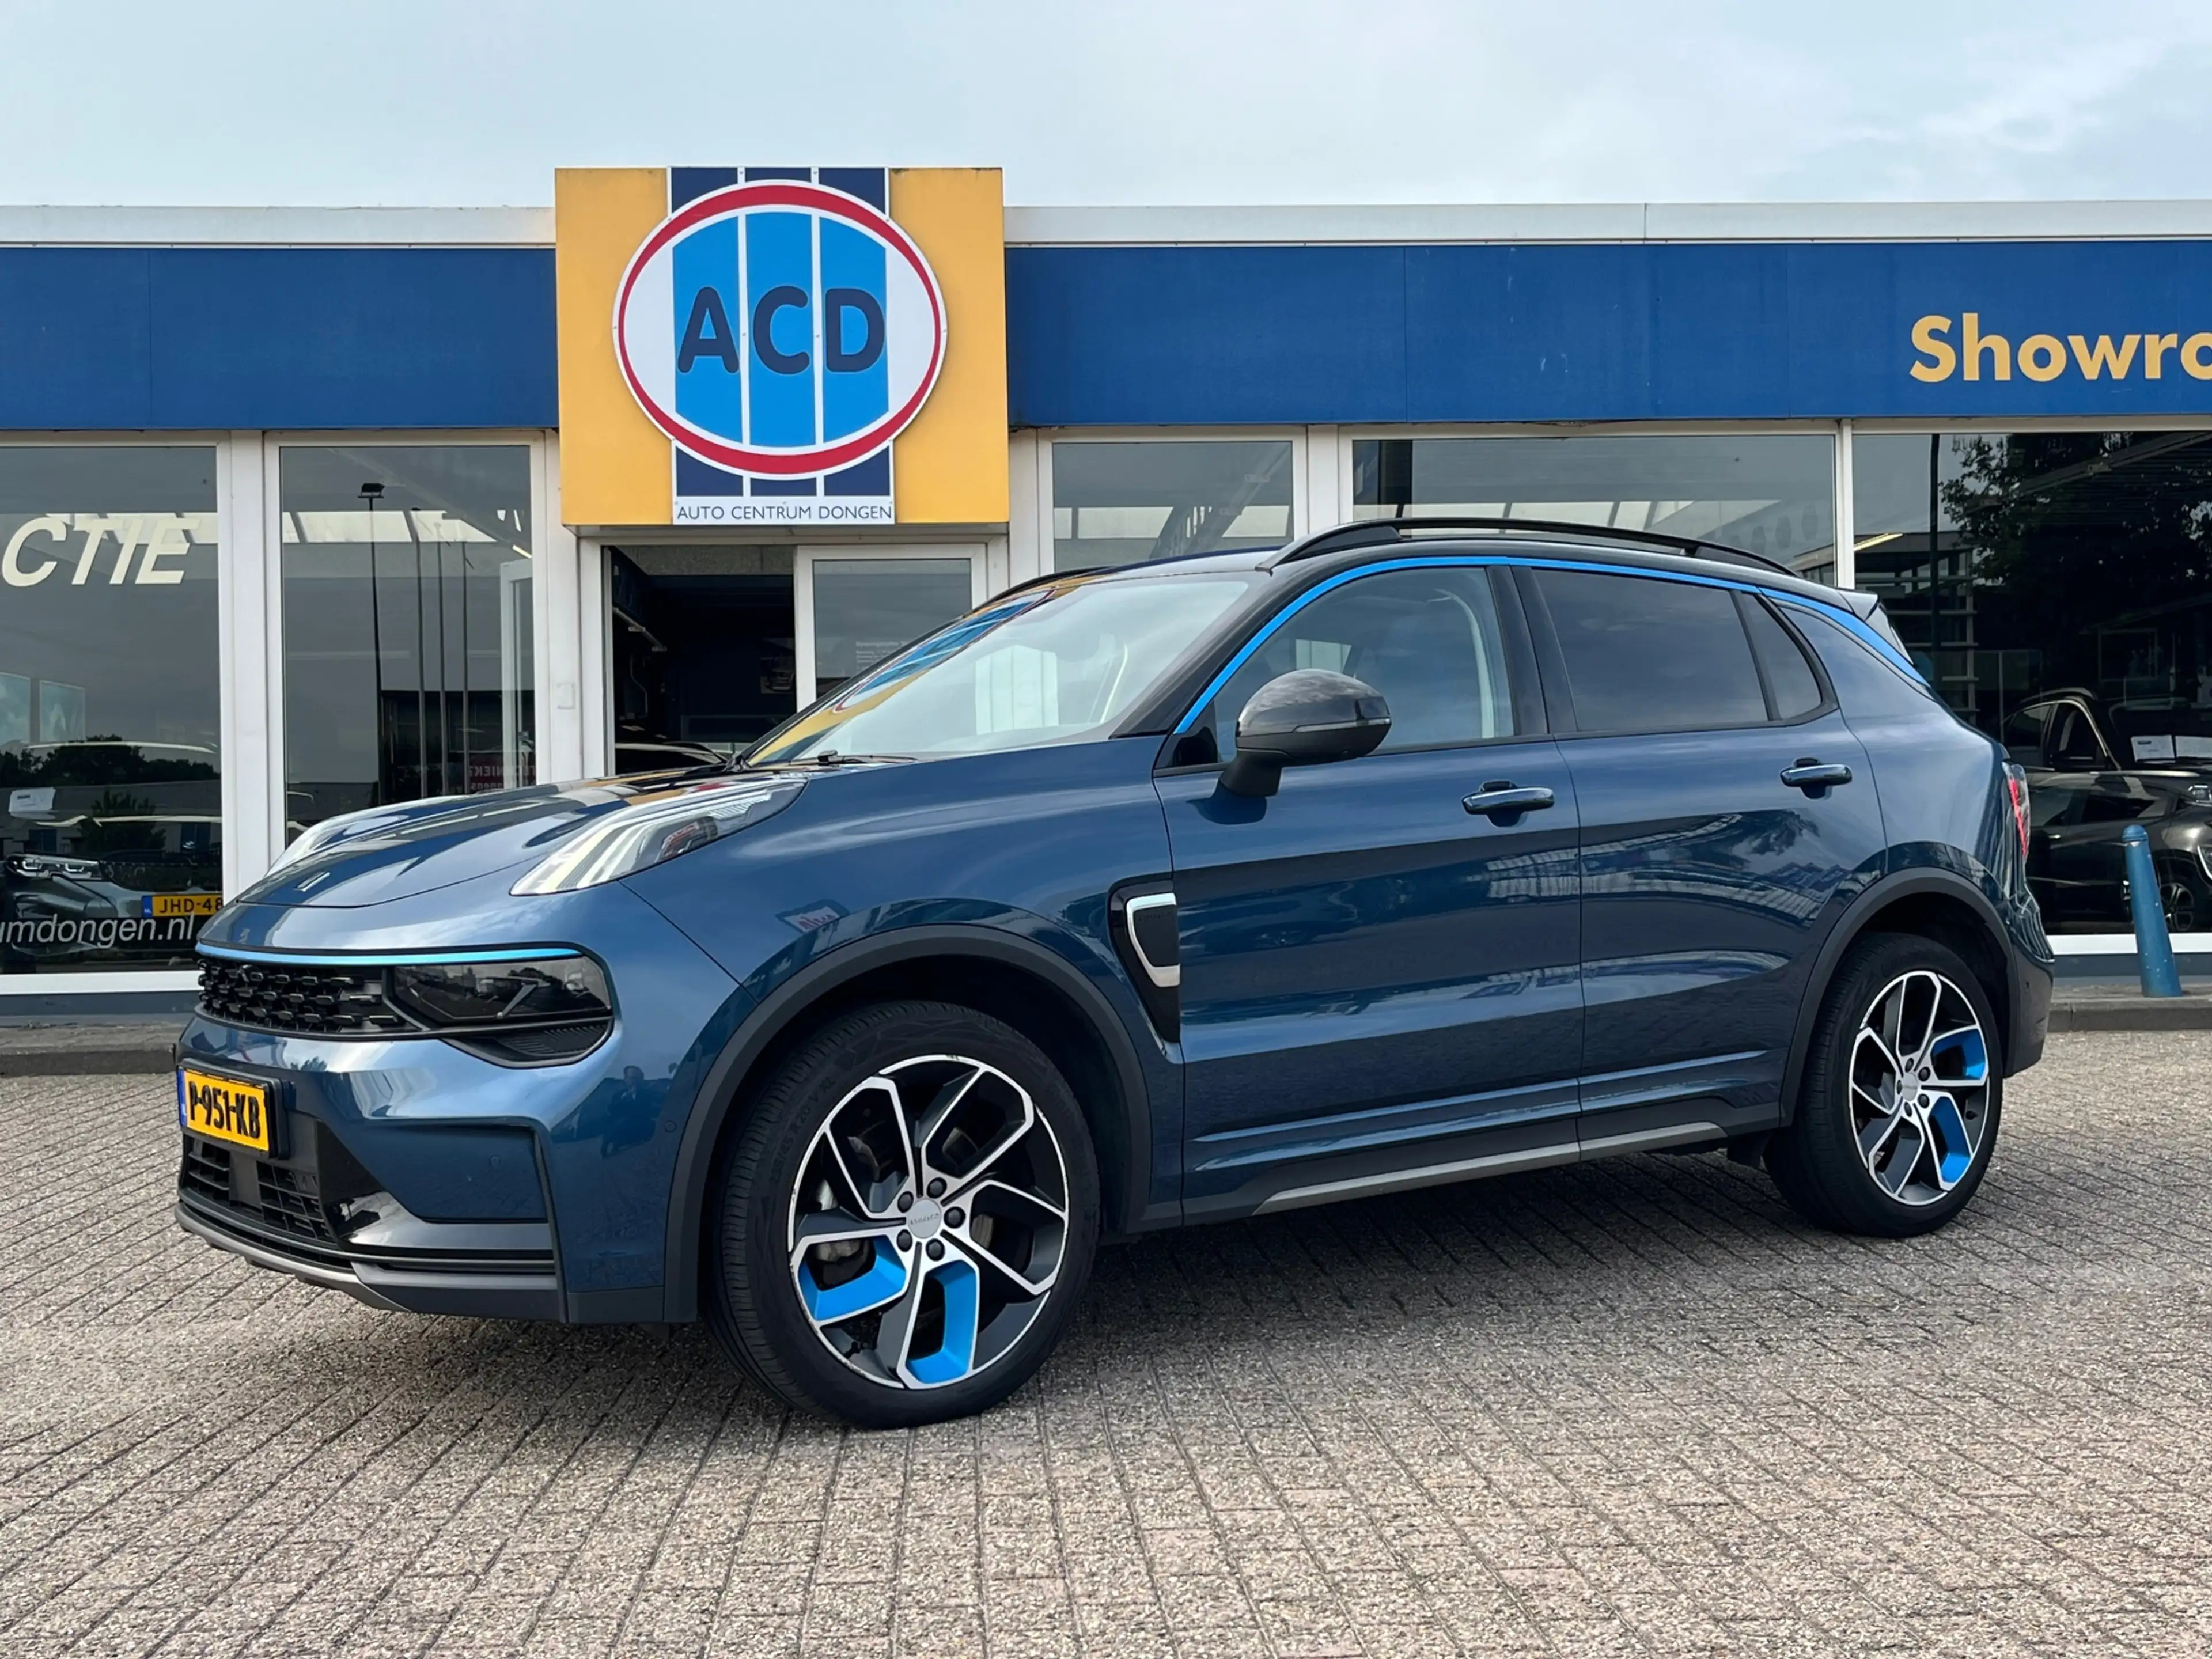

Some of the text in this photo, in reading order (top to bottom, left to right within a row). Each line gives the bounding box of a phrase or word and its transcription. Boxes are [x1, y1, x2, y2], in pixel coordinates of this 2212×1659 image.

[677, 286, 885, 375] ACD
[1909, 312, 2212, 383] Showro
[677, 506, 892, 520] AUTO CENTRUM DONGEN
[2, 517, 201, 588] CTIE
[188, 1080, 262, 1139] P-951-KB
